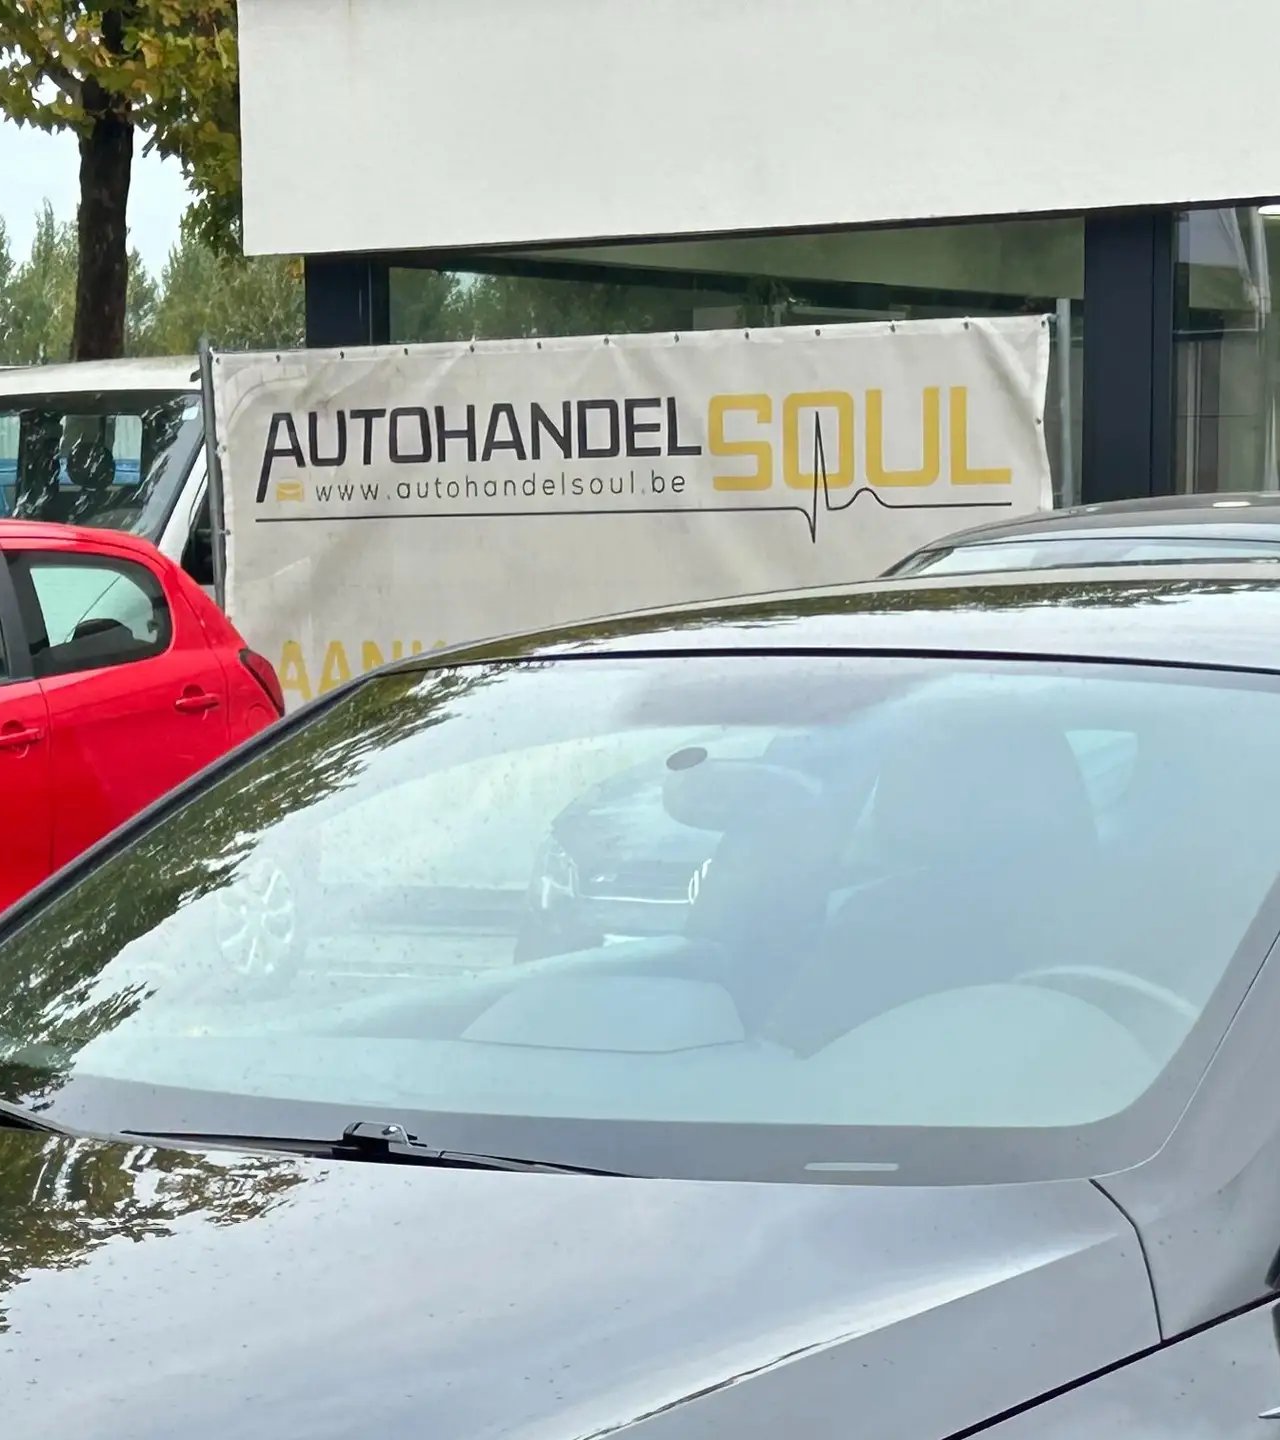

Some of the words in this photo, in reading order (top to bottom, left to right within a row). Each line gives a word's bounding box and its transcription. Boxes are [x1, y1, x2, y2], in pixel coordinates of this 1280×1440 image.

[256, 397, 702, 503] AUTOHANDEL
[708, 386, 1012, 491] SOUL
[316, 470, 686, 501] www.autohandelsoul.be
